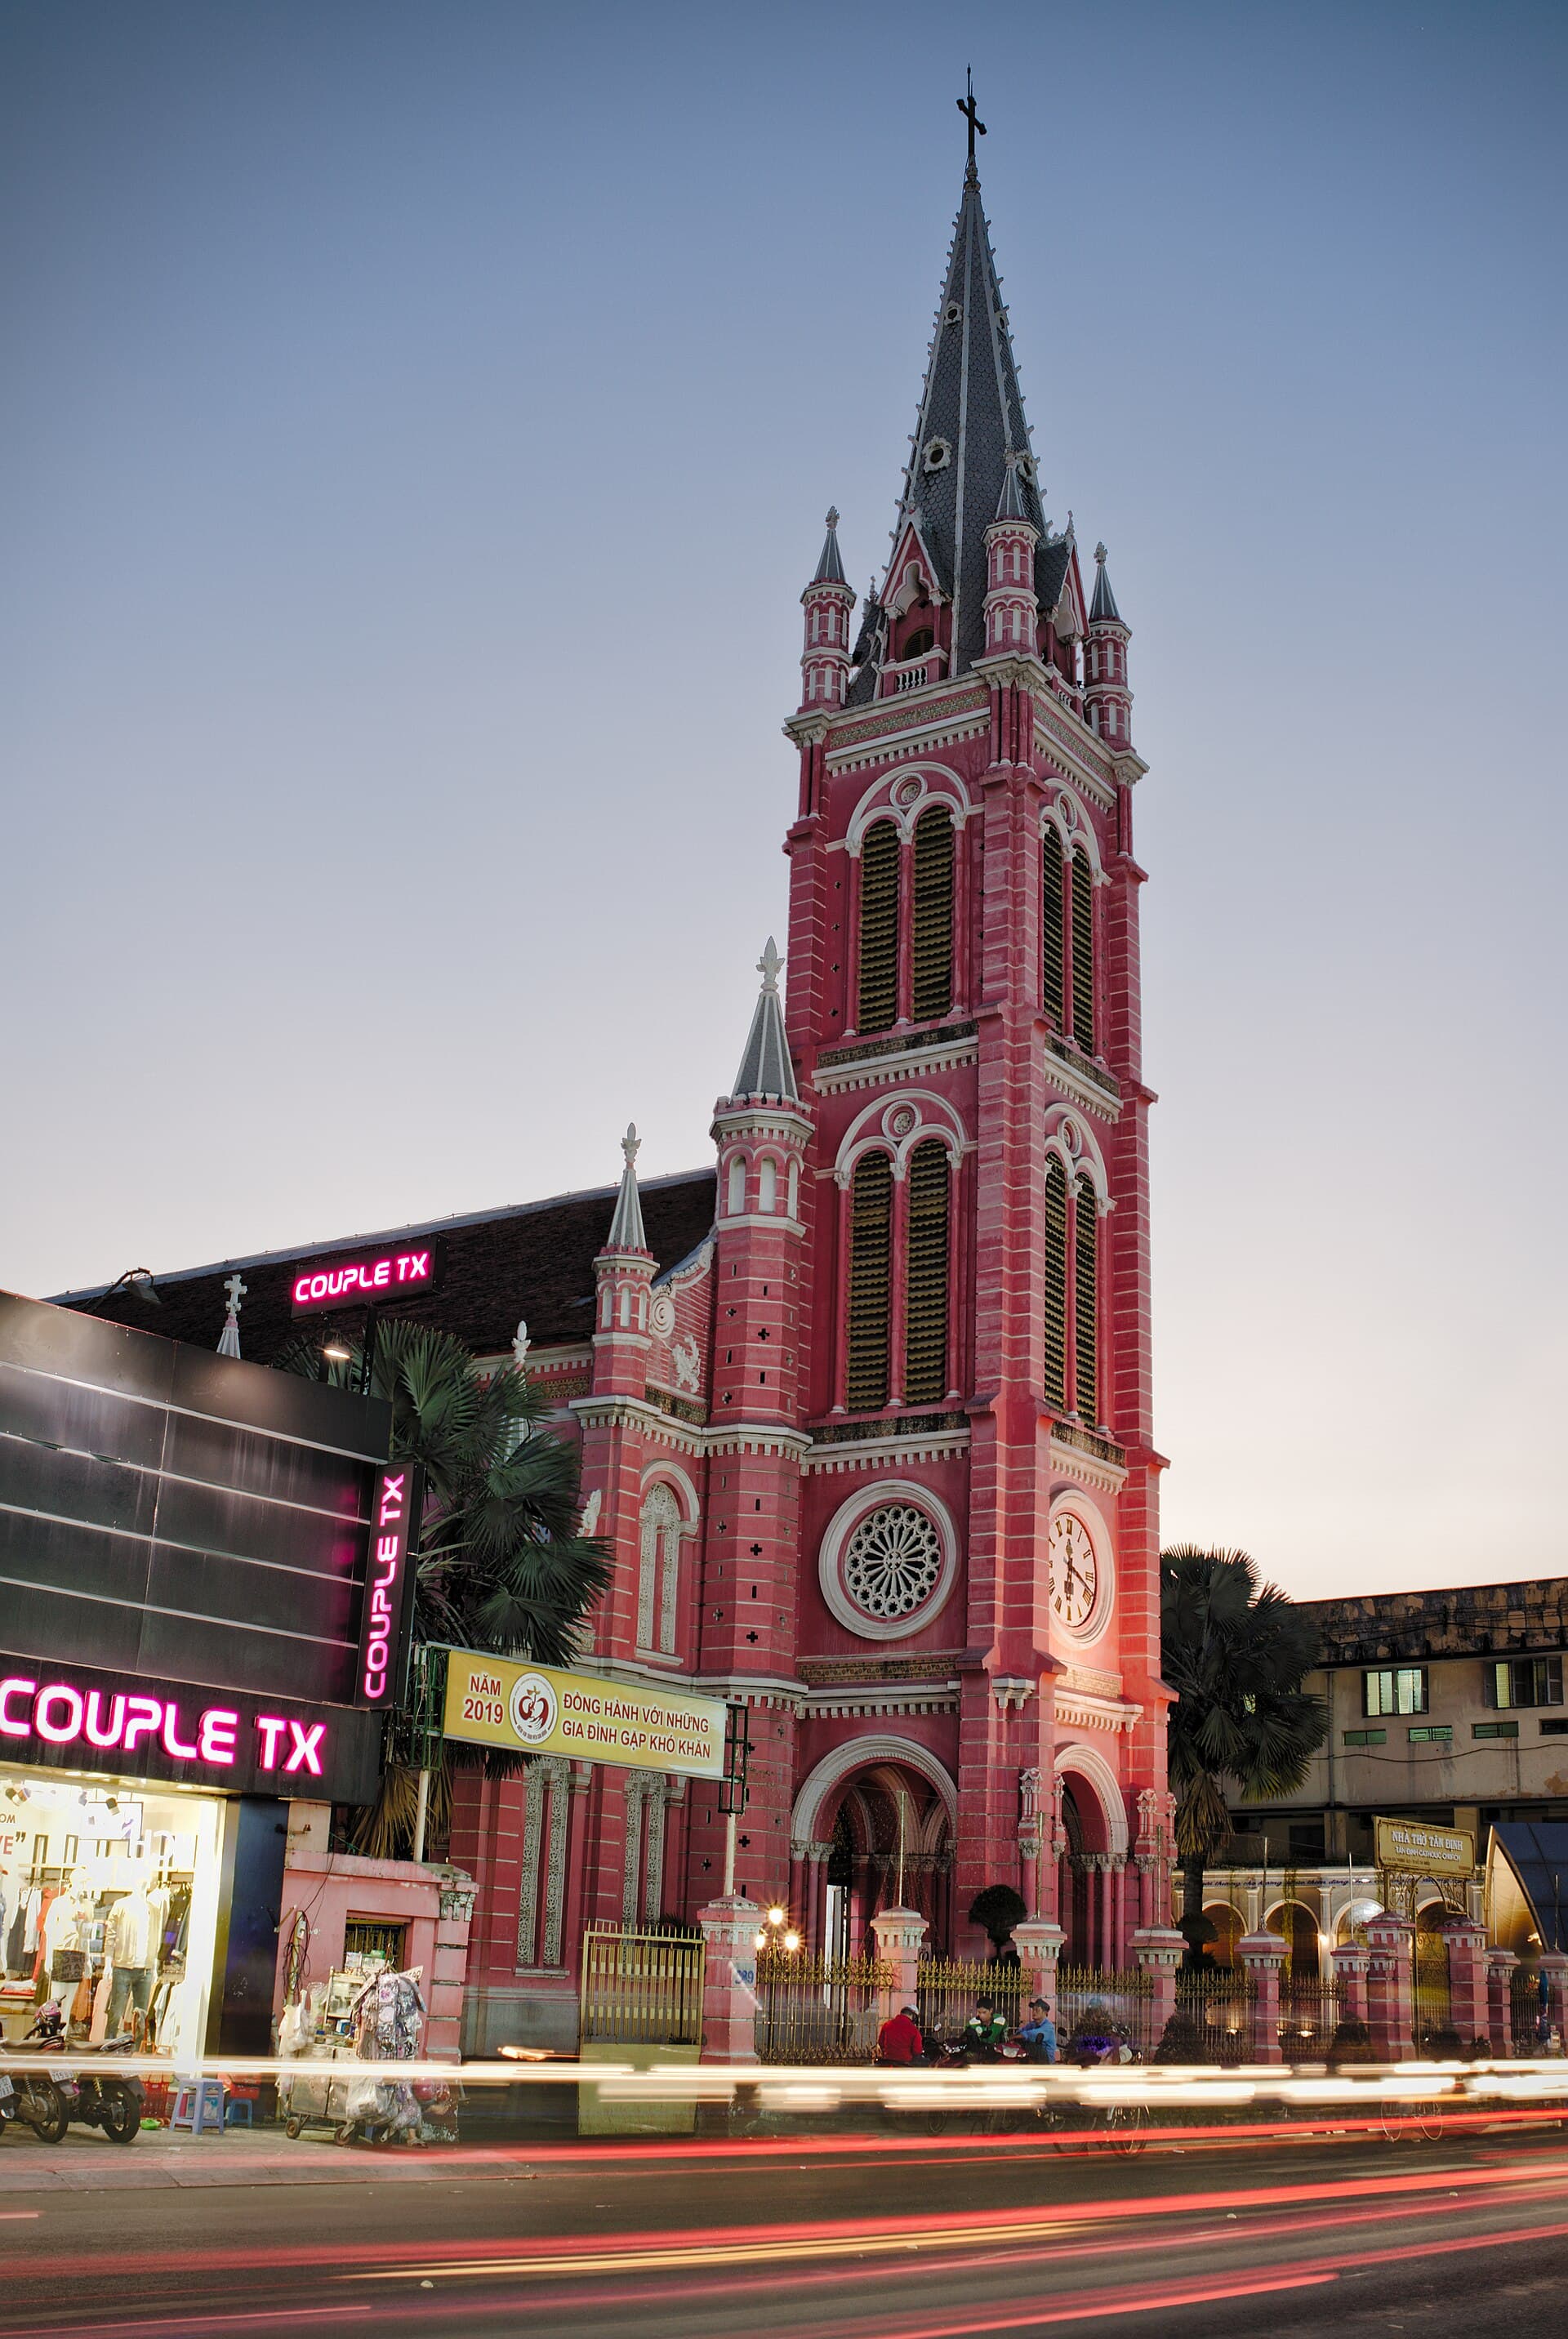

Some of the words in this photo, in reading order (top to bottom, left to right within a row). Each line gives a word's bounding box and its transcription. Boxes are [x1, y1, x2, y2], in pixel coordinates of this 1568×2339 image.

[294, 1261, 391, 1303] COUPLE
[397, 1252, 430, 1281] TX
[379, 1473, 404, 1527] TX
[363, 1535, 399, 1699] COUPLE
[470, 1674, 501, 1697] NĂM
[0, 1677, 239, 1765] COUPLE
[256, 1716, 326, 1775] TX
[463, 1698, 504, 1725] 2019
[563, 1692, 601, 1714] ĐỒNG
[604, 1698, 639, 1721] HÀNH
[643, 1704, 664, 1726] VỚI
[666, 1708, 710, 1733] NHỮNG
[562, 1720, 585, 1739] GIA
[587, 1722, 617, 1744] ĐÌNH
[621, 1730, 647, 1751] GẶP
[649, 1735, 675, 1753] KHÓ
[678, 1739, 710, 1758] KHĂN
[1392, 1829, 1410, 1843] NHÀ
[1411, 1832, 1427, 1847] THỜ
[1428, 1834, 1444, 1847] TÂN
[1446, 1838, 1463, 1851] ĐỊNH
